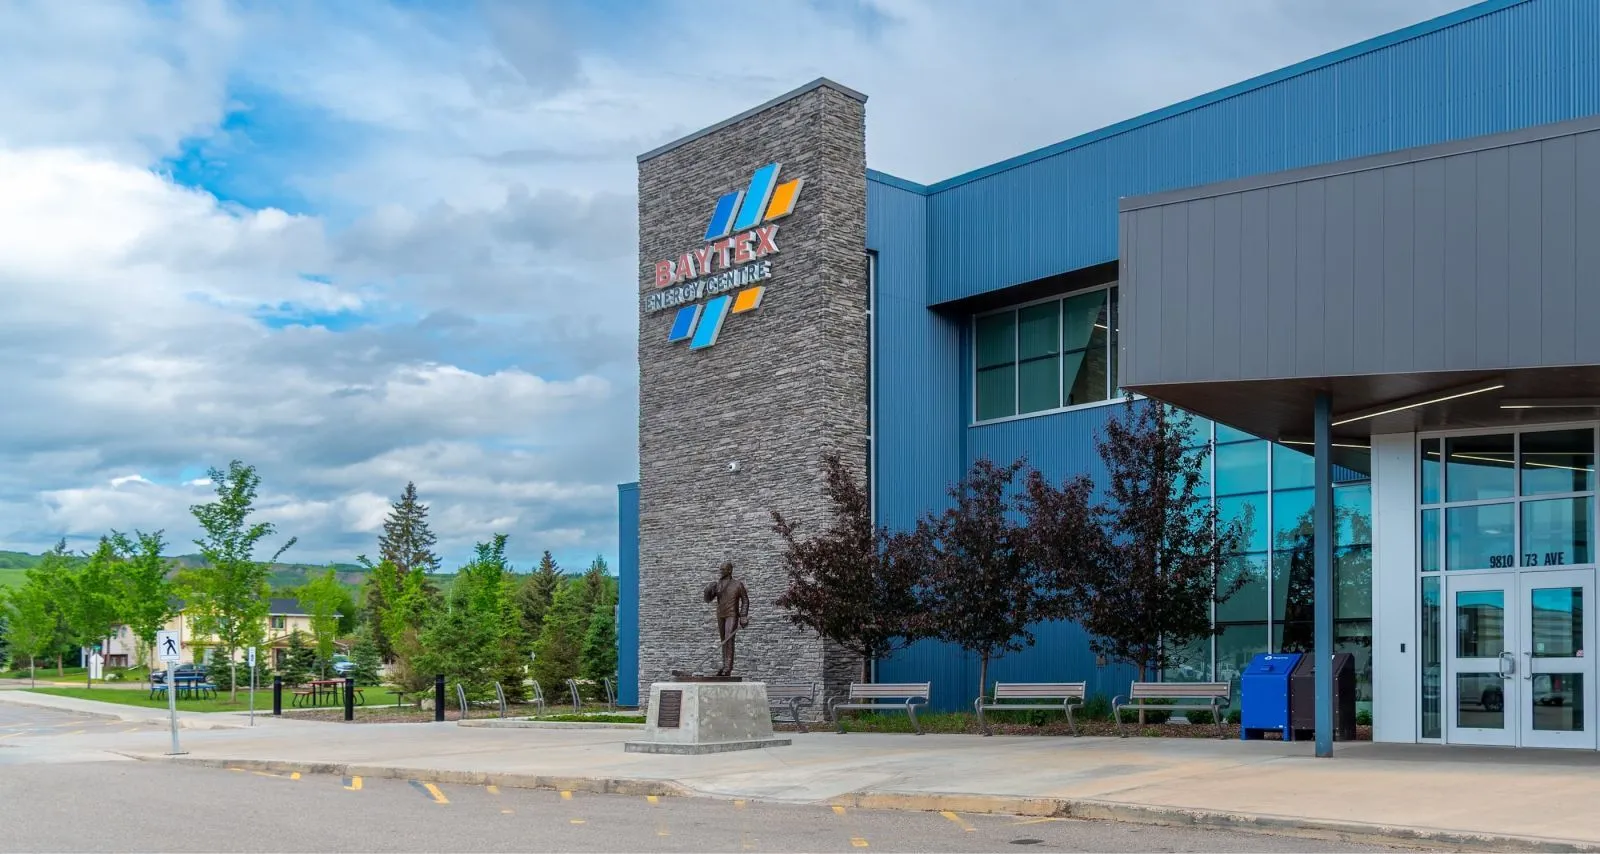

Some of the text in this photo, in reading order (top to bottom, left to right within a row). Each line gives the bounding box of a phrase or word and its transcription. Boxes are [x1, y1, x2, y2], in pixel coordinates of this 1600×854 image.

[655, 224, 780, 288] BAYTEX
[645, 260, 772, 312] ENERGY CENTRE
[1489, 552, 1564, 568] 9810 73 AVE
